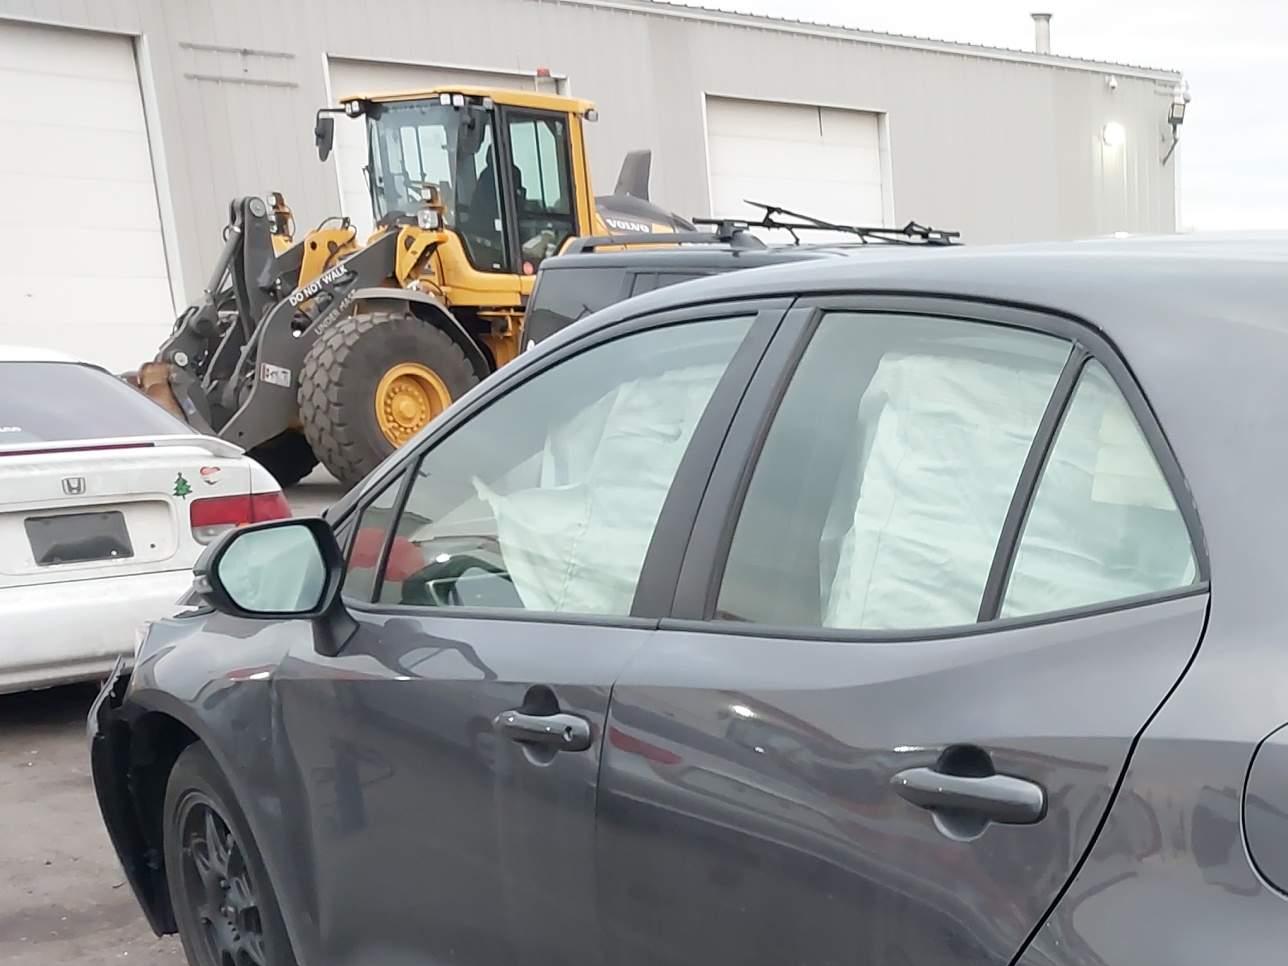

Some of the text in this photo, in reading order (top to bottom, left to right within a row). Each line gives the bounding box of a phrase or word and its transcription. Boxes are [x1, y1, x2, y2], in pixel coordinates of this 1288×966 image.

[606, 219, 649, 232] VOLVO
[288, 264, 348, 307] DO NOT WALK
